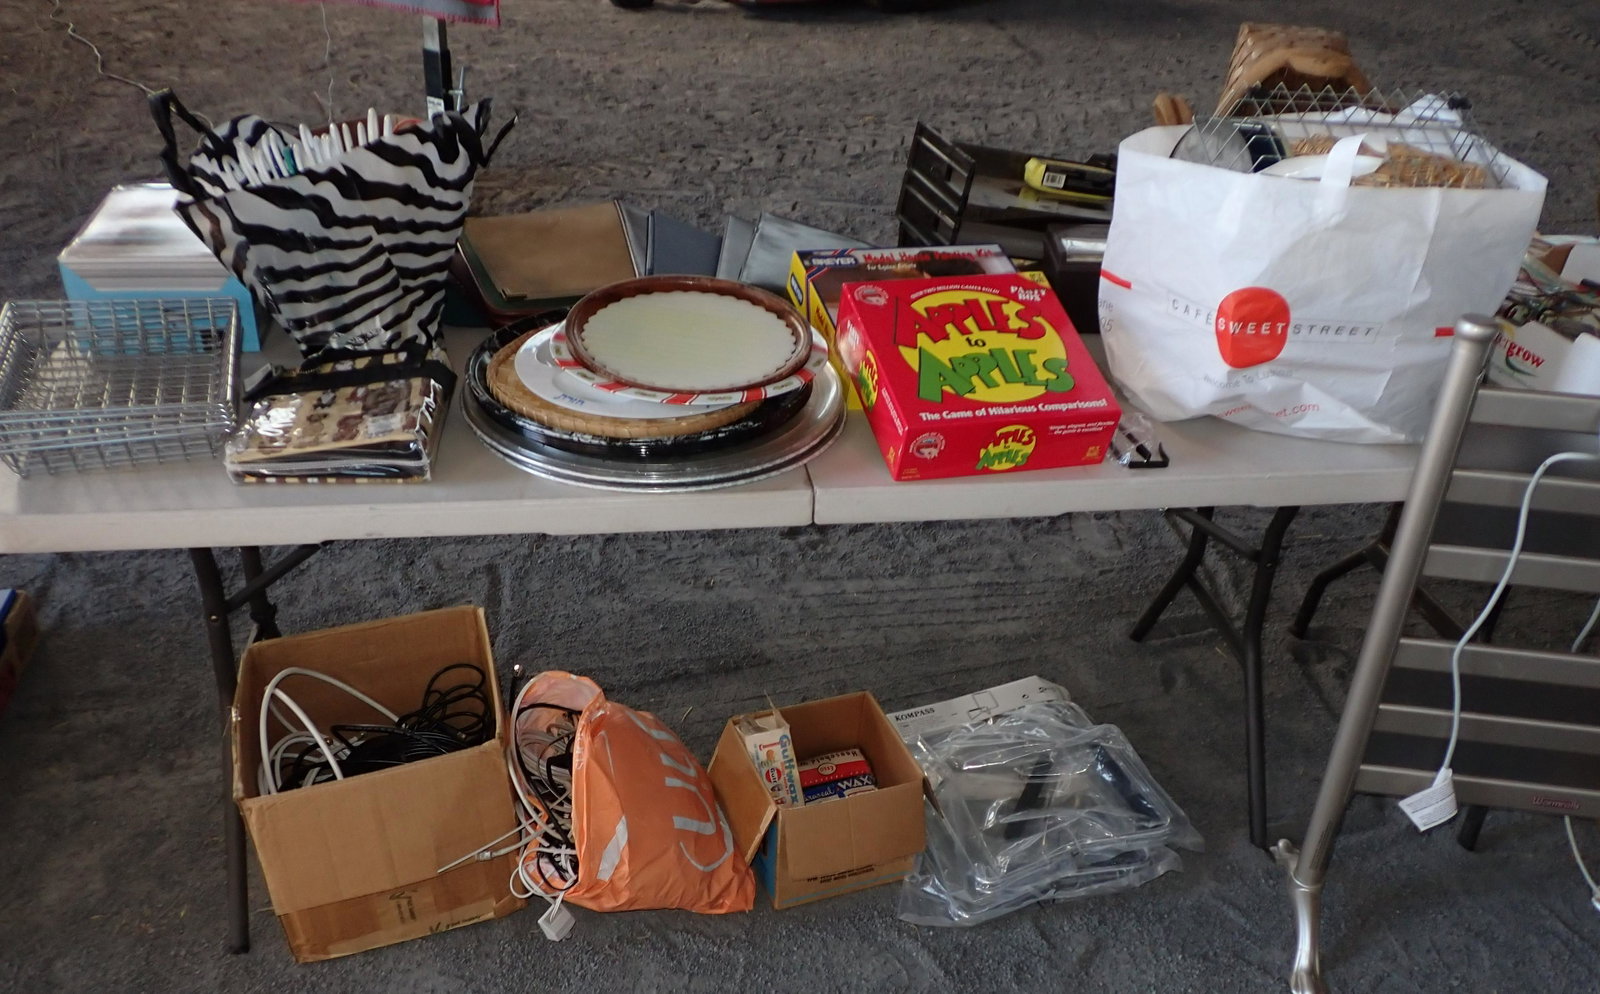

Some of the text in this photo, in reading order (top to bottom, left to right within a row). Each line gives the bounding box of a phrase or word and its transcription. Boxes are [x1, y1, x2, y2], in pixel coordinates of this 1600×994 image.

[812, 256, 855, 266] BREYER
[894, 297, 1047, 347] APPLES
[1171, 297, 1377, 337] CAFÉ SWEET STREET
[965, 337, 986, 348] to
[918, 347, 1075, 403] APPLES
[919, 398, 1108, 421] The Game of Hilarious Comparisons!
[976, 445, 1030, 470] APPLES
[894, 706, 935, 722] KOMPASS
[811, 750, 859, 766] Household
[769, 767, 778, 785] Gulf
[779, 734, 799, 805] Gulfwax
[820, 765, 833, 774] Esso
[837, 775, 872, 791] WAX
